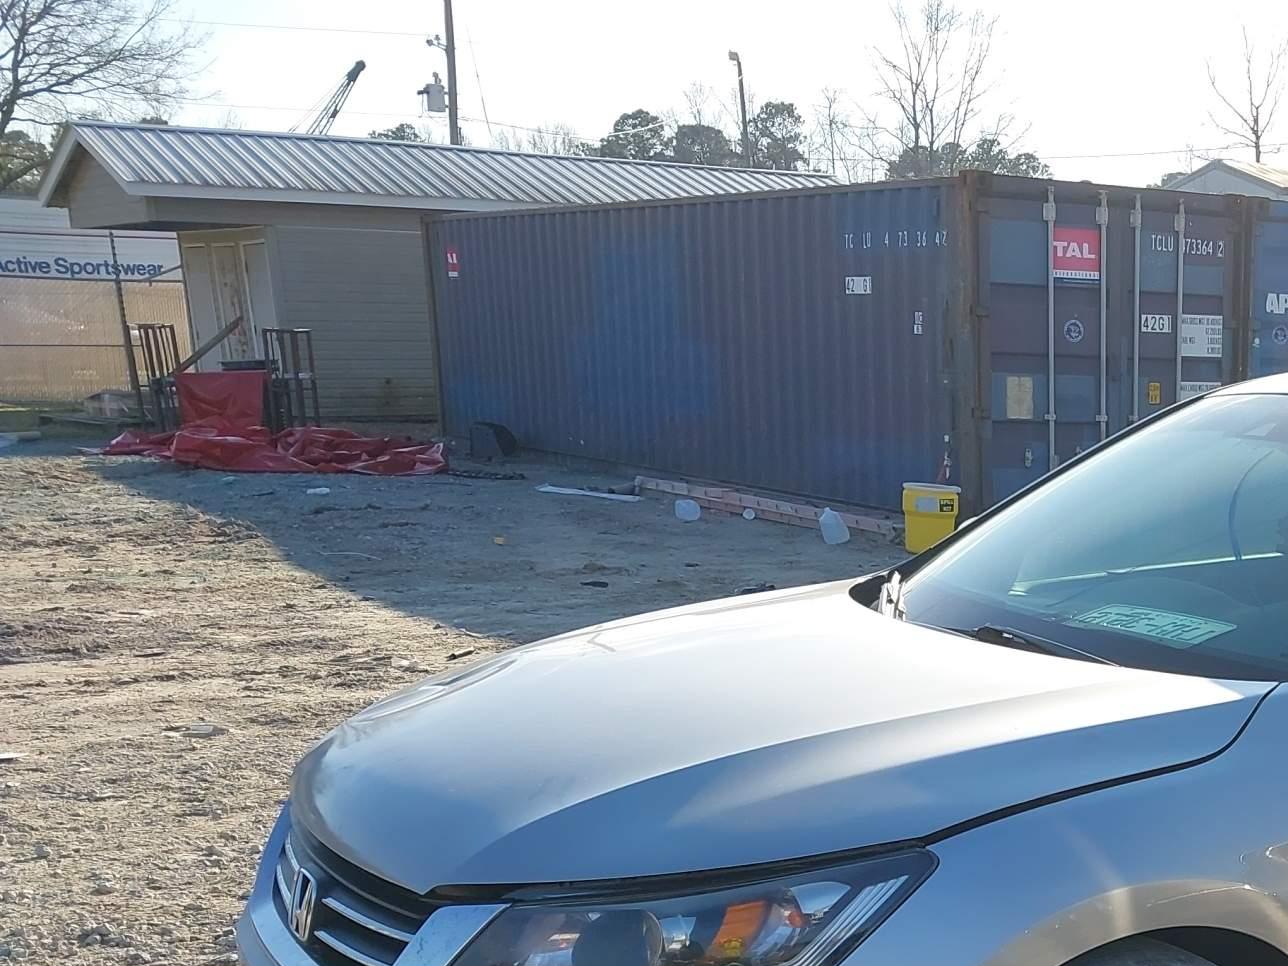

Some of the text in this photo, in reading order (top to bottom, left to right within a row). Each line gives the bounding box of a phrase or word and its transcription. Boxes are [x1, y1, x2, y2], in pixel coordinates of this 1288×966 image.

[1053, 241, 1096, 259] TAL
[1151, 234, 1174, 252] TCLU
[1182, 238, 1213, 256] 73364
[54, 257, 163, 277] Sportswear
[1142, 315, 1170, 331] 42G1
